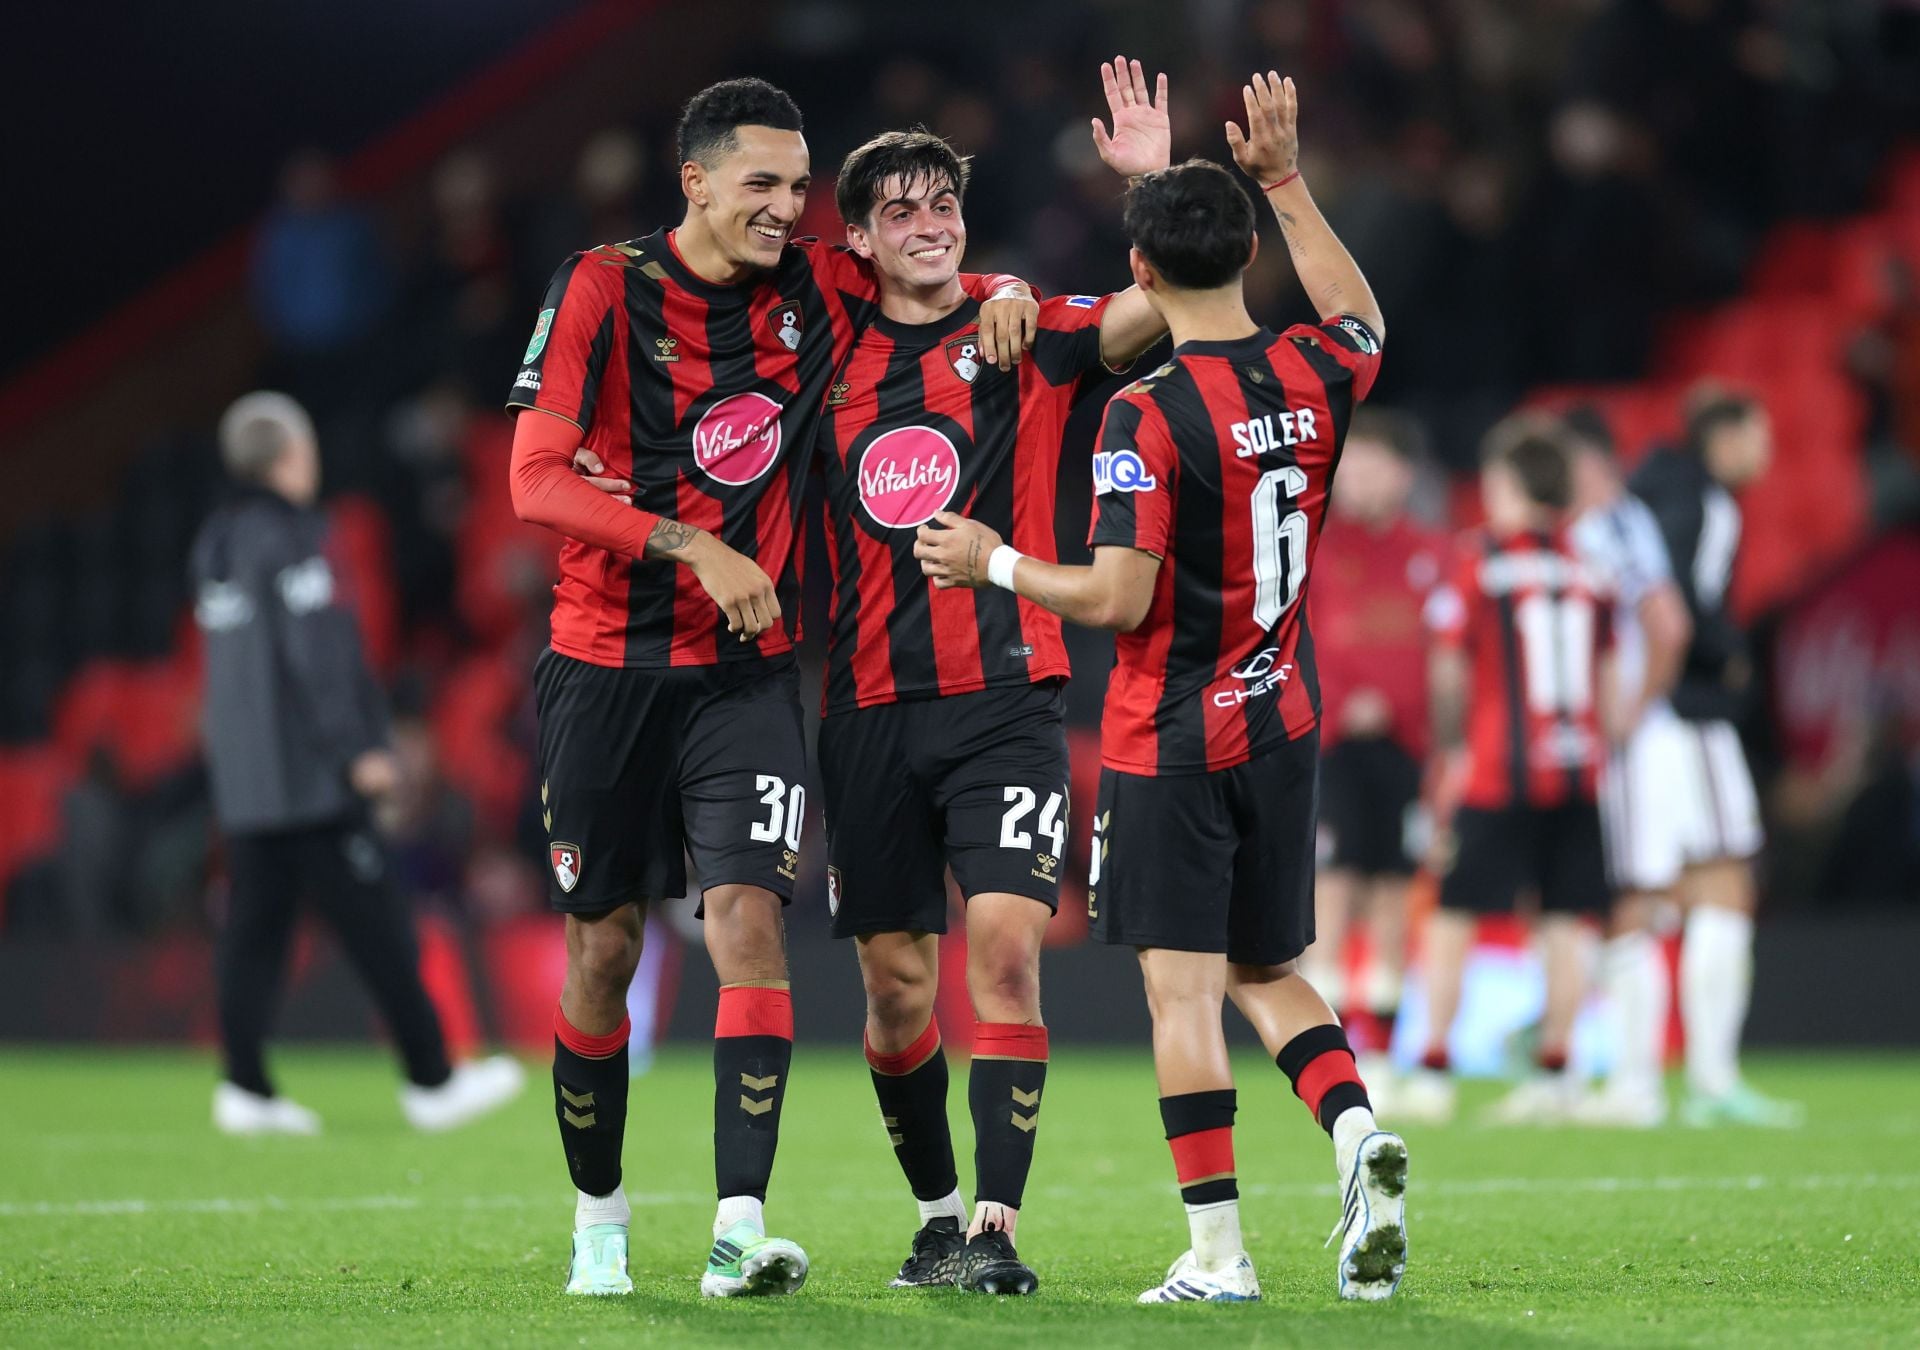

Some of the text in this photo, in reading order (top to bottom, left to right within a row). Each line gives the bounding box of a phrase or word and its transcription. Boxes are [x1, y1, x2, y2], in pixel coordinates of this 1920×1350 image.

[699, 416, 775, 460] Vitality
[1230, 408, 1318, 458] SOLER
[864, 454, 953, 498] Vitality
[1251, 465, 1308, 632] 6
[750, 774, 806, 853] 30
[1000, 786, 1065, 860] 24
